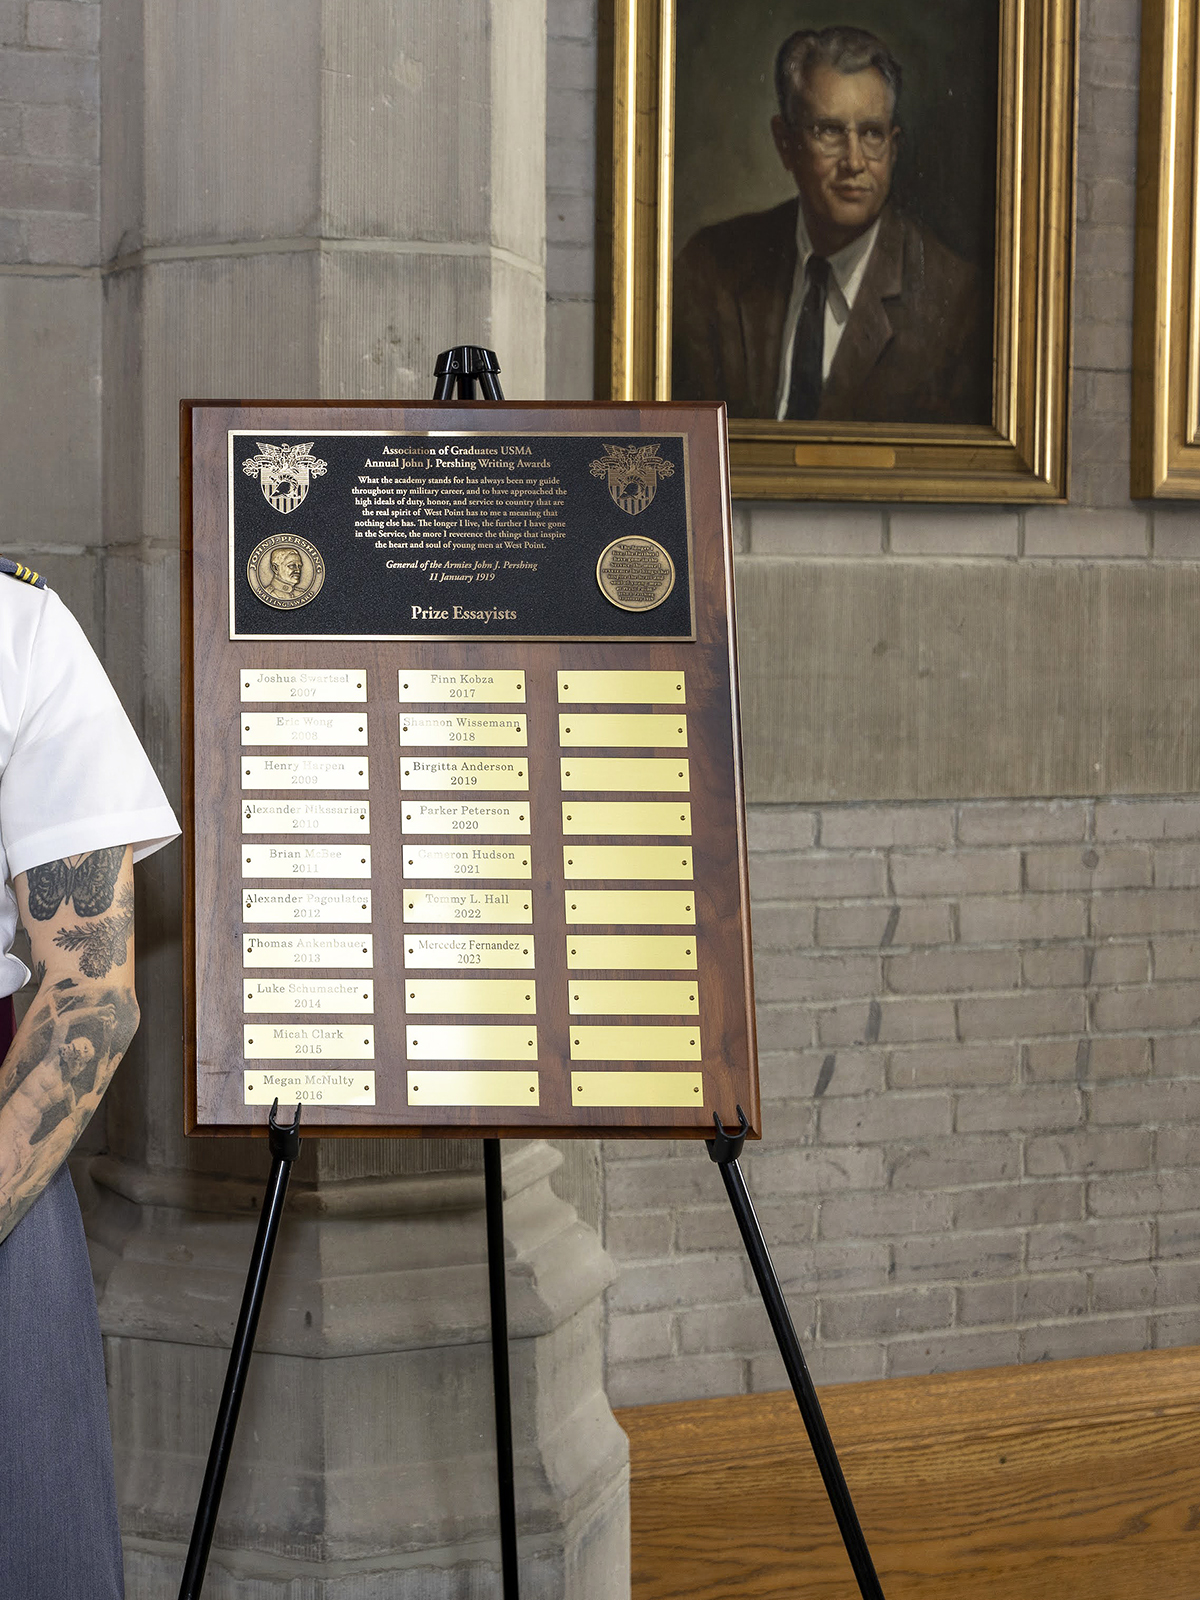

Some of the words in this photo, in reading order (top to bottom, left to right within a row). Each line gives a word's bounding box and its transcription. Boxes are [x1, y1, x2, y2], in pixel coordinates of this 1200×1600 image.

[382, 446, 436, 455] Association
[438, 445, 449, 455] of
[451, 446, 498, 455] Graduates
[501, 446, 532, 455] USMA
[365, 458, 399, 467] Annual
[401, 458, 423, 469] John
[426, 459, 432, 469] J.
[436, 458, 476, 470] Pershing
[478, 459, 514, 470] Writing
[517, 459, 550, 467] Awards
[394, 476, 426, 485] academy
[480, 476, 504, 486] always
[539, 477, 559, 486] guide
[352, 486, 394, 496] throughout
[410, 487, 439, 496] military
[511, 488, 553, 496] approached
[355, 497, 372, 507] high
[406, 497, 425, 507] duty,
[391, 509, 411, 518] spirit
[510, 510, 541, 518] meaning
[355, 519, 384, 529] nothing
[434, 519, 457, 529] longer
[378, 530, 407, 538] Service,
[499, 530, 522, 540] things
[541, 531, 566, 540] inspire
[250, 542, 268, 570] JOHN
[281, 536, 322, 574] PERSHING
[386, 560, 418, 568] General
[420, 560, 430, 571] of
[430, 560, 442, 568] the
[472, 560, 492, 570] John
[493, 561, 500, 570] J.
[503, 561, 538, 571] Pershing
[439, 573, 473, 583] January
[411, 606, 448, 619] Prize
[453, 606, 516, 624] Essayists
[257, 674, 297, 683] Joshua
[431, 674, 456, 683] Finn
[460, 674, 494, 684] Kobza
[290, 688, 317, 697] 2007
[449, 689, 475, 698] 2017
[403, 717, 453, 726] Shannon
[456, 718, 520, 727] Wissemann
[449, 732, 475, 741] 2018
[264, 760, 299, 771] Henry
[413, 761, 457, 773] Birgitta
[461, 761, 514, 770] Anderson
[451, 776, 477, 785] 2019
[244, 804, 301, 814] Alexander
[420, 805, 458, 815] Parker
[461, 806, 510, 815] Peterson
[452, 820, 478, 830] 2020
[269, 848, 300, 858] Brian
[305, 848, 342, 858] McBee
[418, 849, 468, 859] Cameron
[472, 849, 515, 859] Hudson
[292, 864, 318, 873] 2011
[454, 864, 480, 874] 2021
[245, 894, 303, 903] Alexander
[307, 894, 369, 905] Pagoulatos
[426, 894, 466, 905] Tommy
[470, 894, 481, 904] L.
[485, 894, 509, 904] Hall
[294, 908, 320, 918] 2012
[454, 909, 481, 918] 2022
[249, 938, 293, 948] Thomas
[297, 938, 366, 948] Ankenbauer
[419, 940, 466, 950] Mercedez
[469, 940, 520, 950] Fernandez
[294, 953, 320, 962] 2013
[458, 954, 481, 964] 2023
[257, 984, 285, 993] Luke
[289, 984, 358, 993] Schumacher
[294, 999, 321, 1008] 2014
[273, 1029, 308, 1038] Micah
[312, 1029, 343, 1038] Clark
[295, 1044, 322, 1054] 2015
[264, 1075, 301, 1086] Megan
[305, 1075, 354, 1087] McNulty
[295, 1090, 323, 1100] 2016
